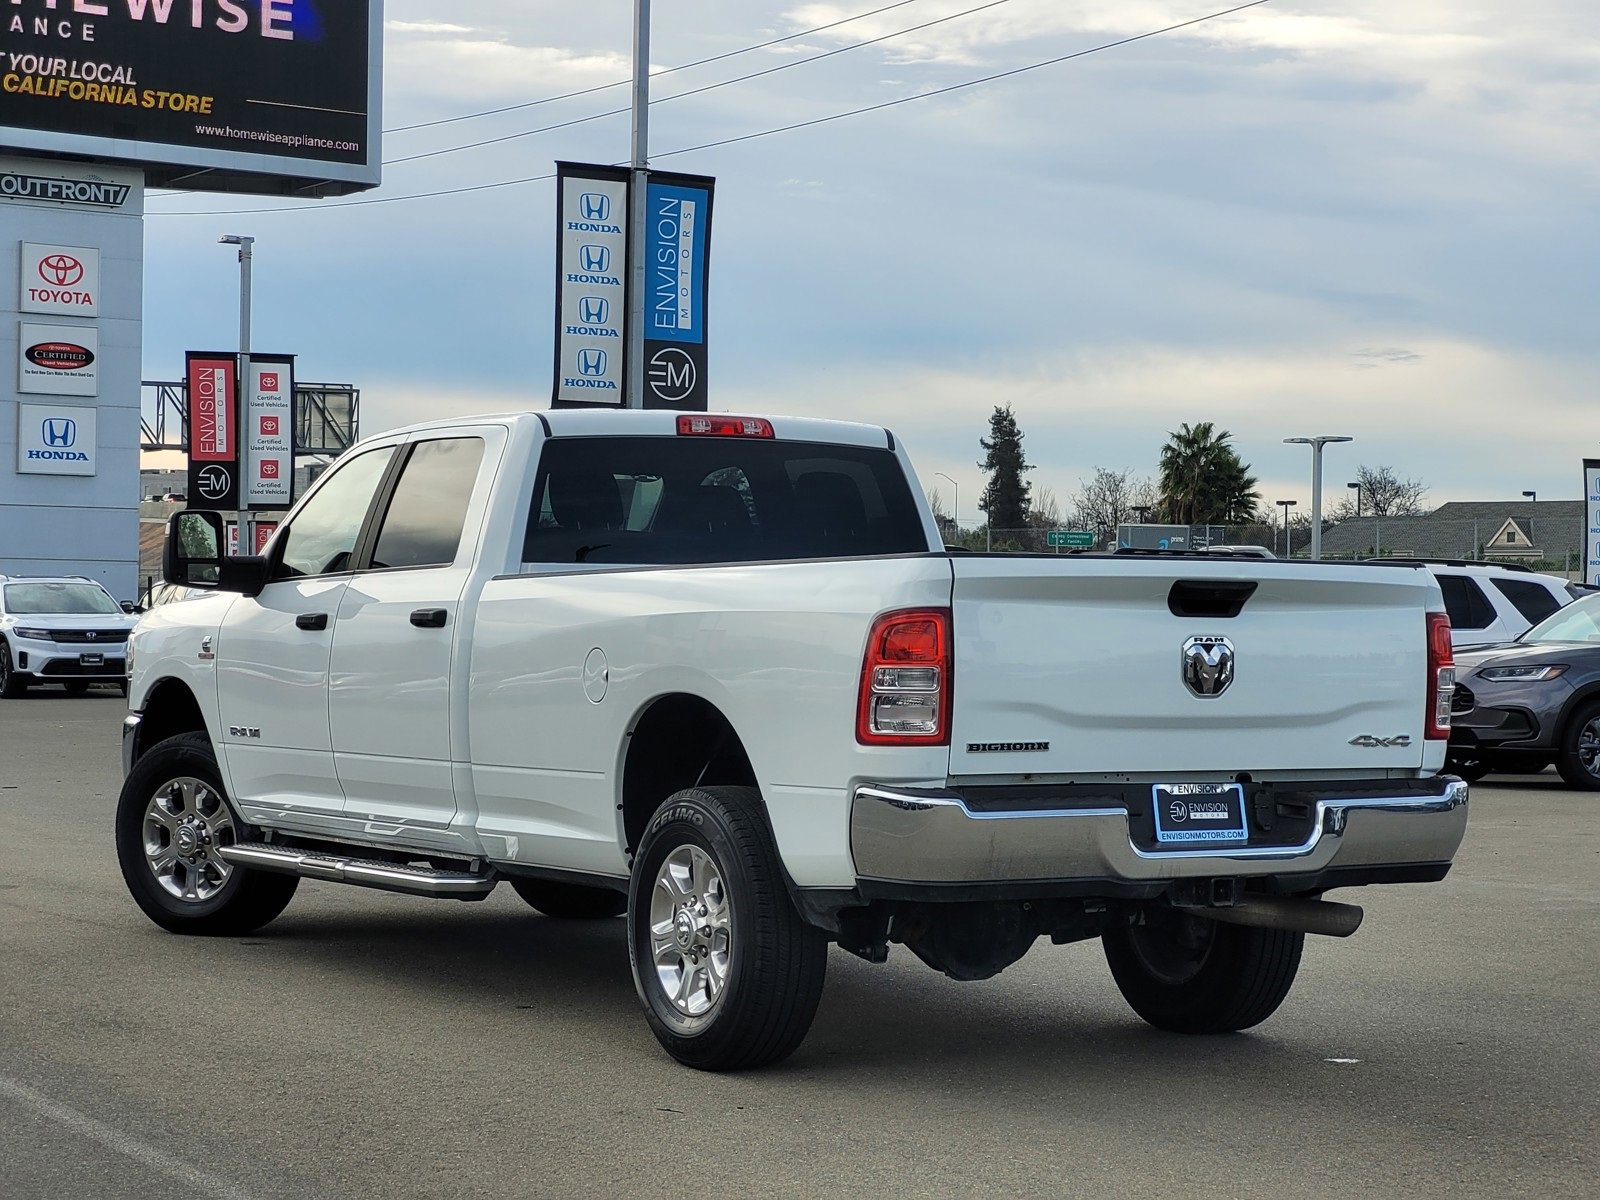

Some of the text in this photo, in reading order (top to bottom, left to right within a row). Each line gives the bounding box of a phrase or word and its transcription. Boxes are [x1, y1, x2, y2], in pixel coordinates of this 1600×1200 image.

[9, 52, 137, 86] YOUR LOCAL
[3, 73, 214, 114] CALIFORNIA STORE
[195, 124, 359, 152] www.homewiseappliance.com
[568, 222, 621, 234] HONDA
[654, 197, 679, 328] ENVISION
[681, 212, 691, 319] MOTORS
[567, 273, 620, 286] HONDA
[28, 288, 92, 306] TOYOTA
[566, 326, 619, 338] HONDA
[564, 378, 617, 389] HONDA
[198, 367, 215, 454] ENVISION
[27, 449, 89, 462] HONDA
[229, 725, 261, 739] RAM
[966, 741, 1050, 753] BIGHORN
[1178, 784, 1217, 794] ENVISION
[1188, 802, 1228, 812] ENVISION
[1161, 831, 1245, 840] ENVISIONMOTORS.COM
